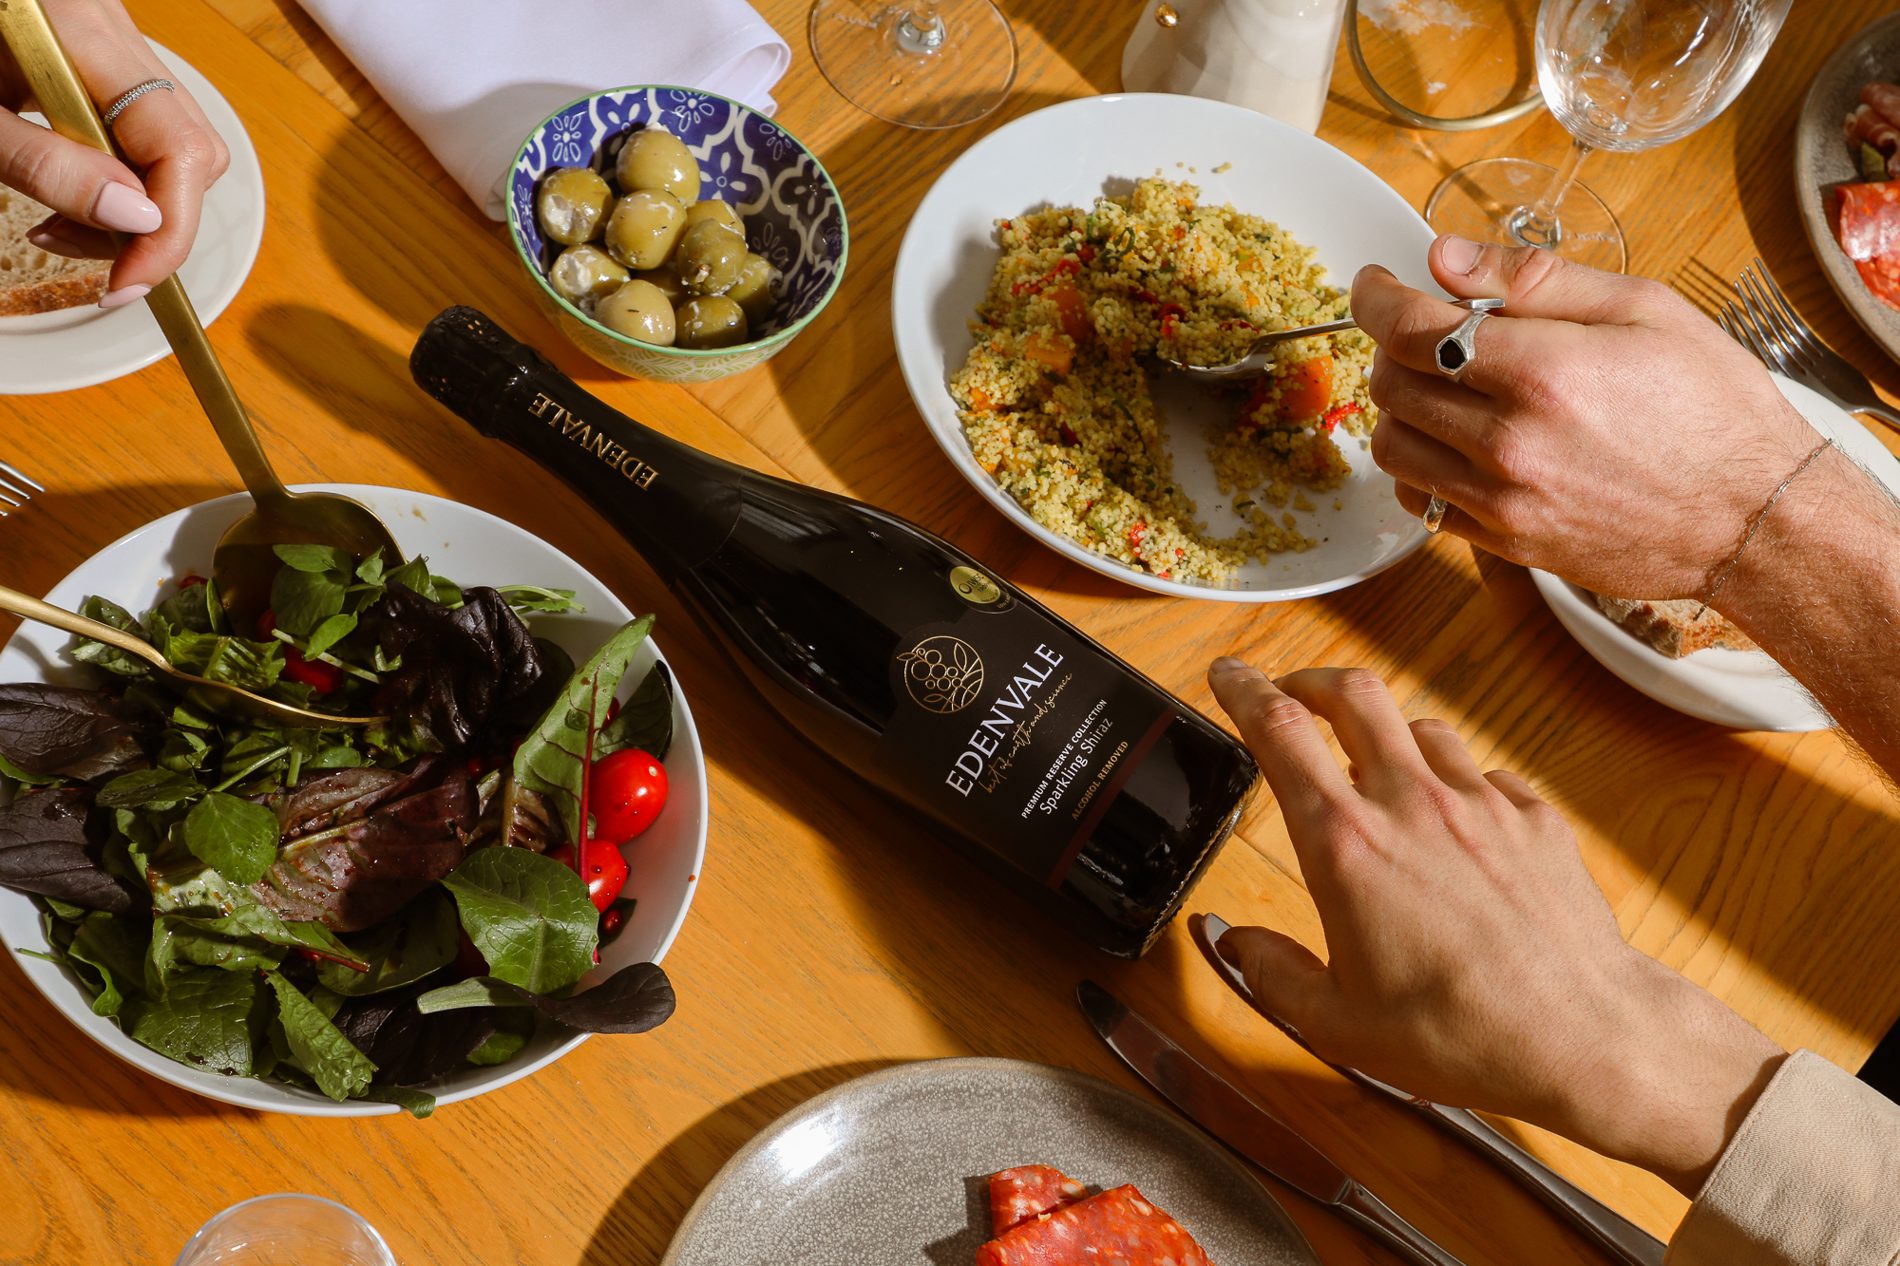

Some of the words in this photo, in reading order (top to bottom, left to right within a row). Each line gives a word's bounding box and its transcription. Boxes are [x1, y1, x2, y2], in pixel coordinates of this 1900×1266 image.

[528, 392, 660, 491] EDENVALE
[945, 643, 1064, 797] EDENVALE
[1008, 720, 1031, 758] earth
[1030, 703, 1048, 727] and
[1045, 673, 1073, 708] science
[1021, 780, 1049, 819] PREMIUM
[1045, 743, 1074, 780] RESERVE
[1071, 699, 1108, 744] COLLECTION
[1040, 754, 1089, 814] Sparkling
[1080, 718, 1114, 754] Shiraz
[1071, 780, 1101, 820] ALCOHOL
[1097, 741, 1129, 780] REMOVED
